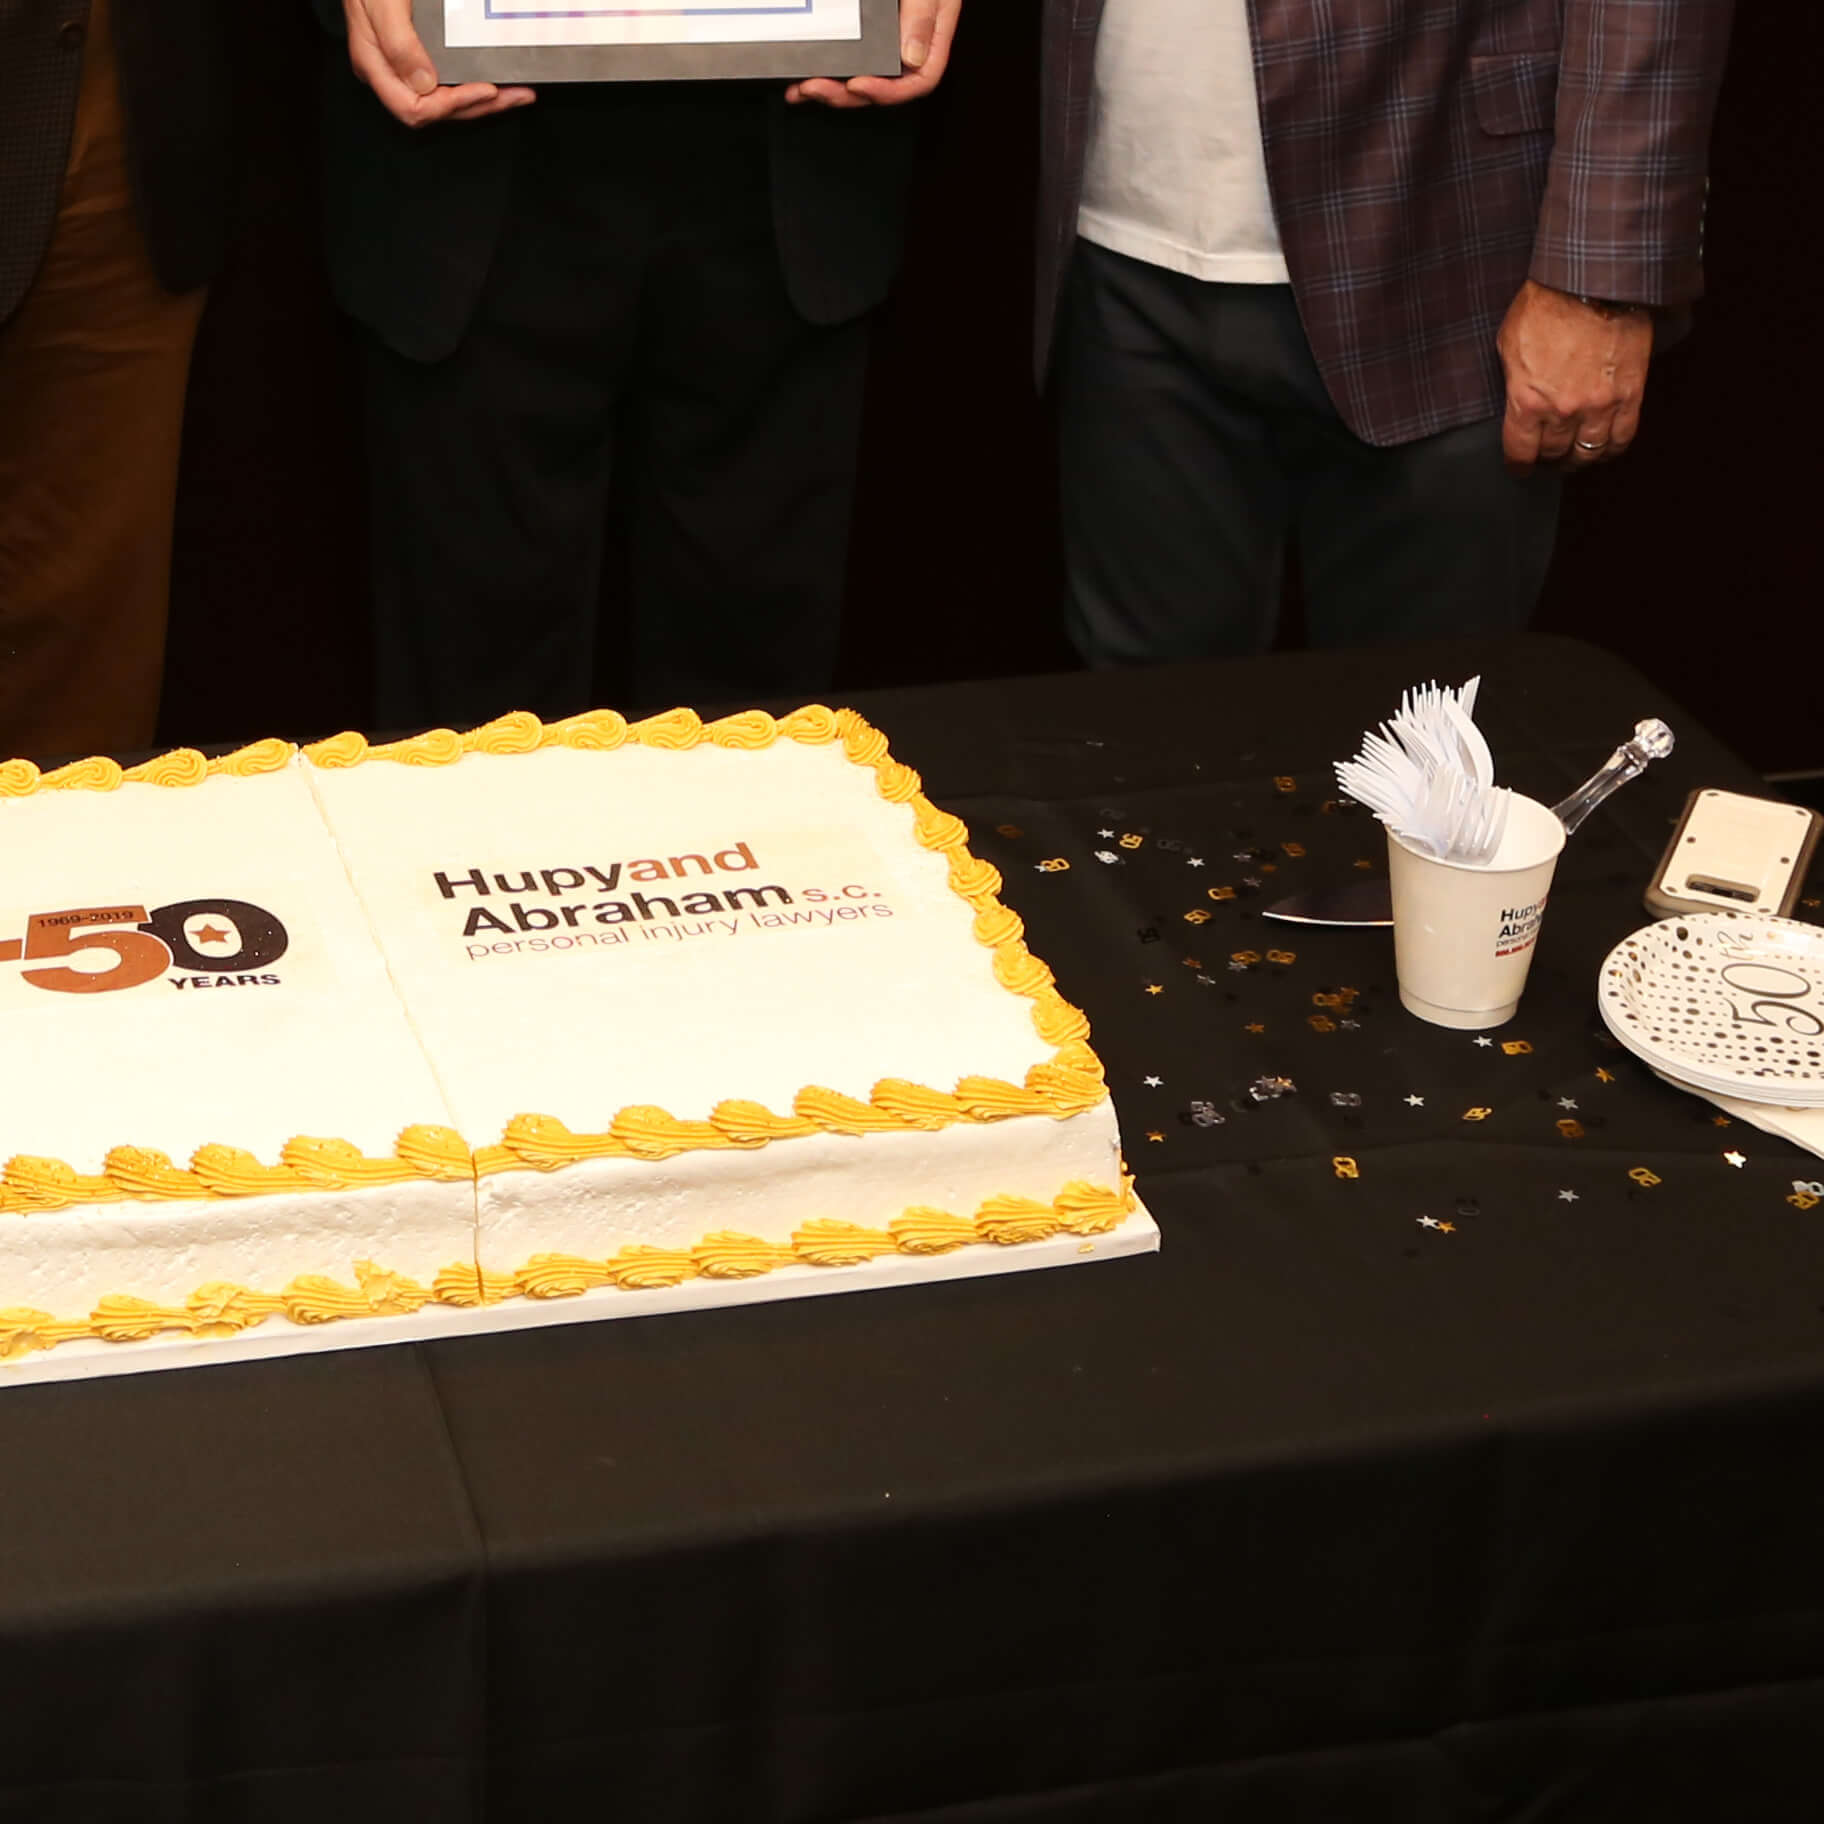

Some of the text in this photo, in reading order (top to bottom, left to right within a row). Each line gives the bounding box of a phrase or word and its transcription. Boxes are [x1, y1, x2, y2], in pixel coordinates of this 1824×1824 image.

[432, 842, 760, 900] Hupyand
[37, 911, 134, 928] 1969-2019
[462, 881, 883, 936] Abraham s.c.
[466, 899, 894, 961] personal injury lawyers
[20, 898, 289, 994] 50
[167, 973, 282, 990] YEARS
[1721, 962, 1824, 1036] 50
